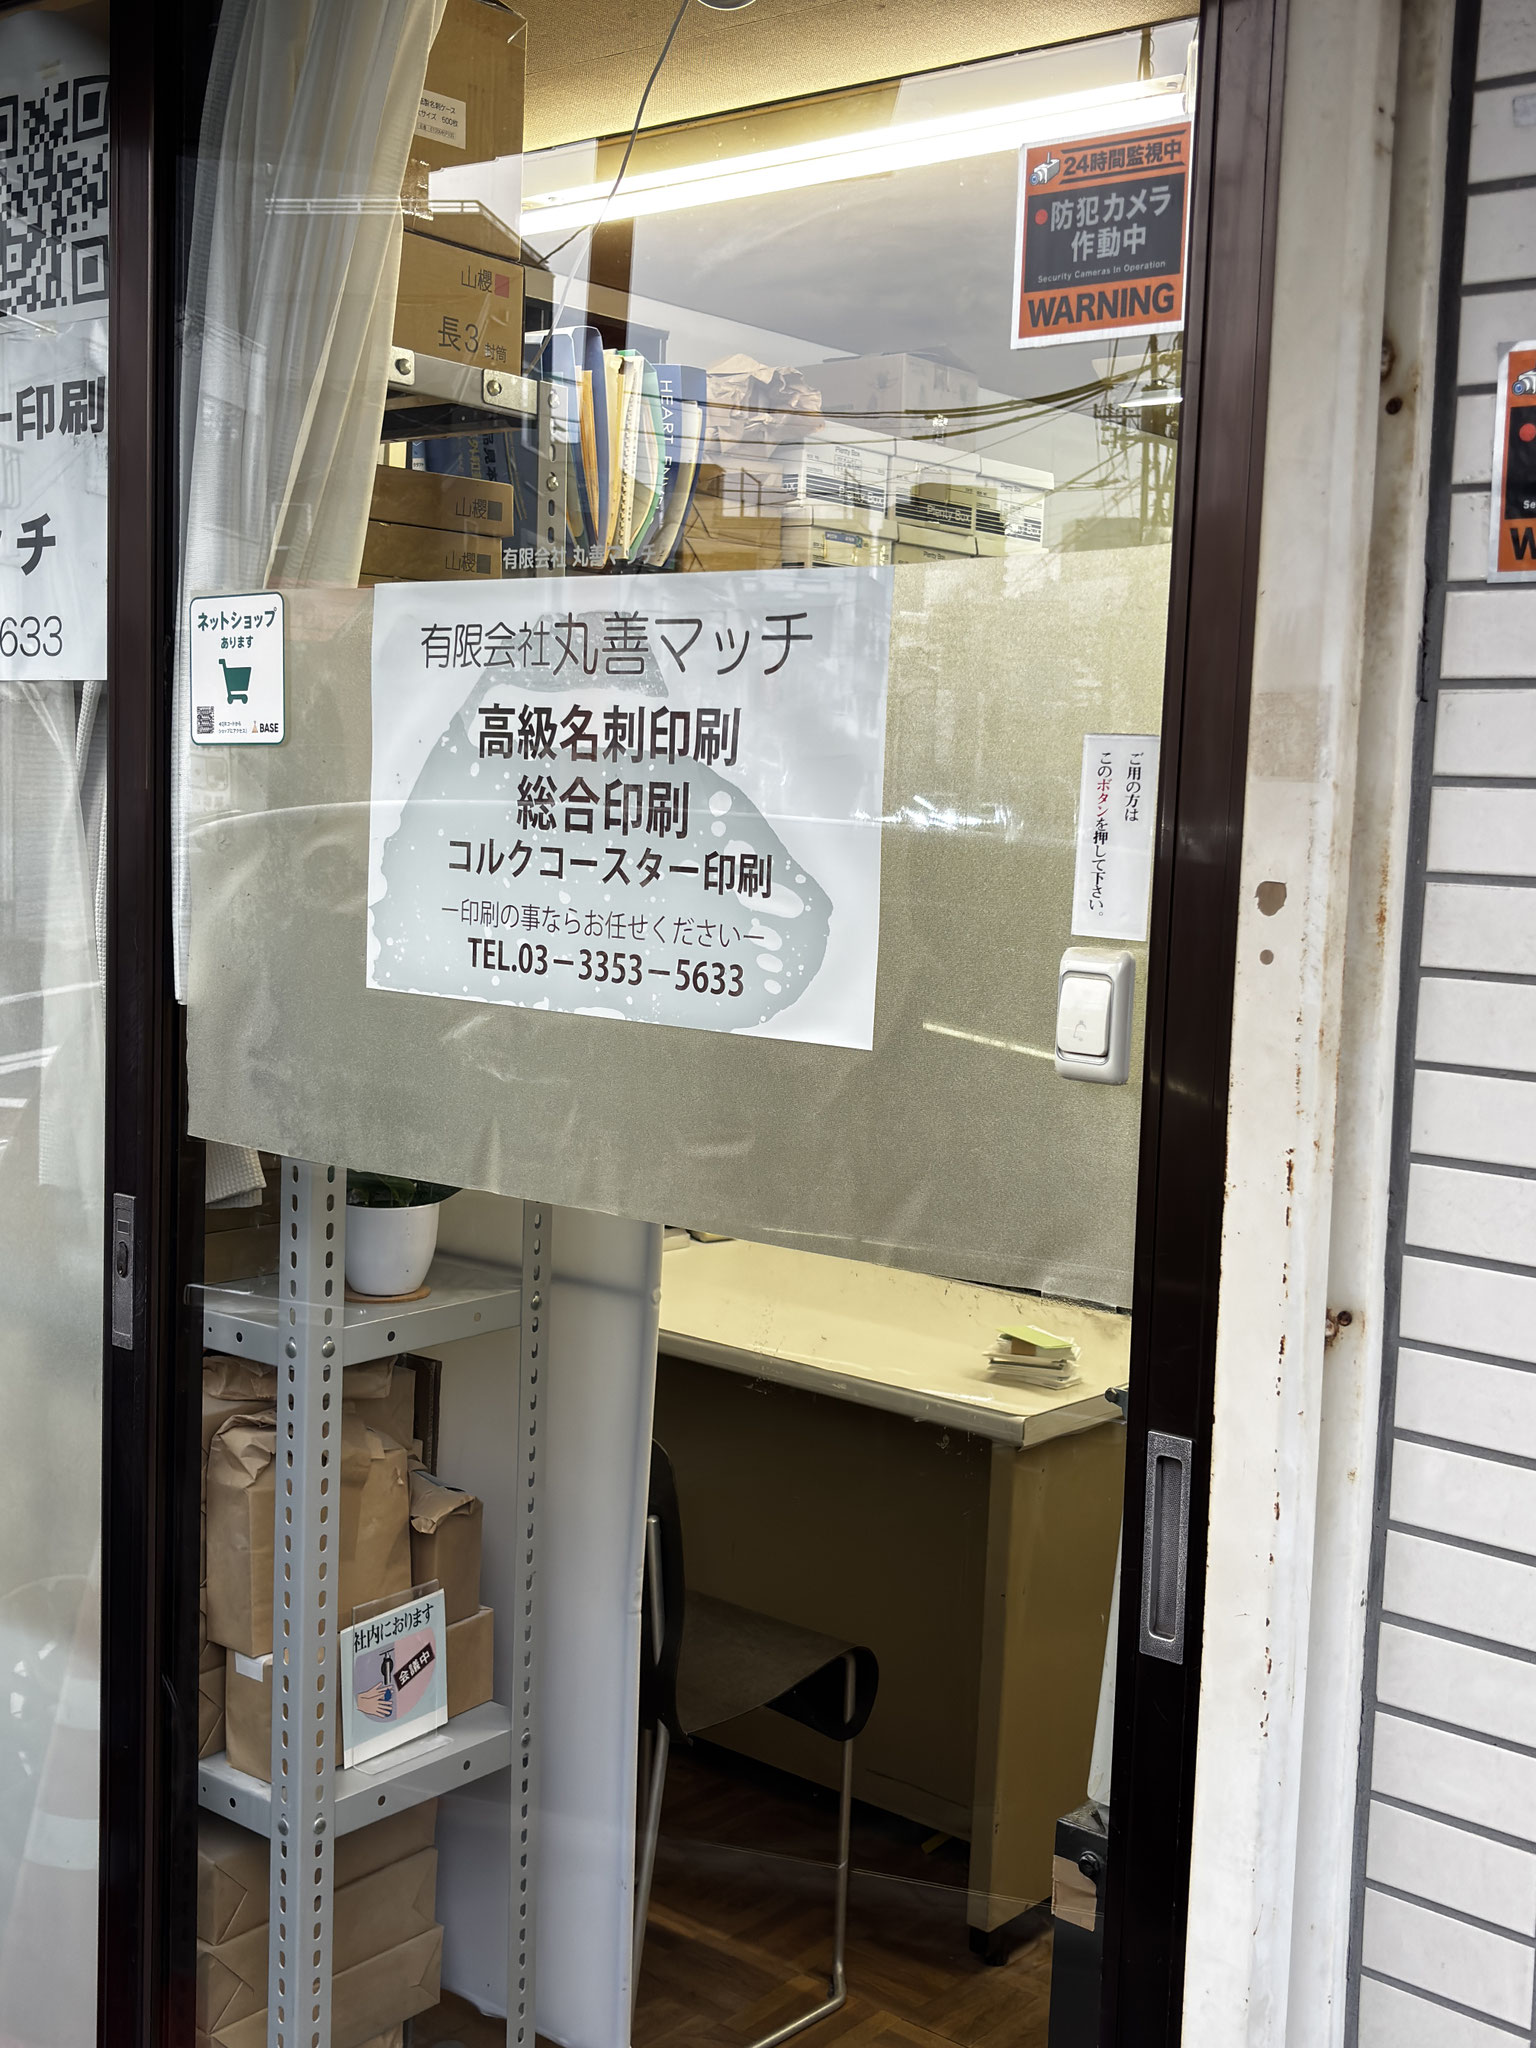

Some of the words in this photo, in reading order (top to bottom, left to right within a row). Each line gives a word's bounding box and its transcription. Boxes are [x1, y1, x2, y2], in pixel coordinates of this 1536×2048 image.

[1063, 139, 1182, 176] 24時間監視中
[1050, 185, 1171, 232] 防犯カメラ
[1071, 223, 1147, 262] 作動中
[1038, 272, 1072, 284] Security
[1074, 267, 1111, 279] Cameras
[1113, 265, 1121, 273] In
[1123, 260, 1166, 274] Operation
[1028, 282, 1175, 328] WARNING
[438, 316, 478, 353] 長3
[484, 342, 507, 363] 封筒
[659, 380, 674, 445] HEART
[956, 511, 972, 522] Box
[0, 513, 56, 576] チ
[503, 547, 566, 570] 有限会社
[572, 545, 657, 569] 丸善マッチ
[198, 606, 278, 631] ネットショップ
[220, 635, 254, 649] あります
[421, 612, 813, 675] 有限会社丸善マッチ
[259, 722, 280, 733] BASE
[478, 702, 742, 767] 高級名刺印刷
[516, 775, 690, 839] 総合印刷
[1124, 752, 1144, 822] ご用の方は
[1089, 752, 1112, 917] このボタンを押して下さい。
[448, 839, 773, 899] コルクコースター印刷
[353, 1602, 434, 1653] 社内におります
[398, 1650, 431, 1685] 会議中
